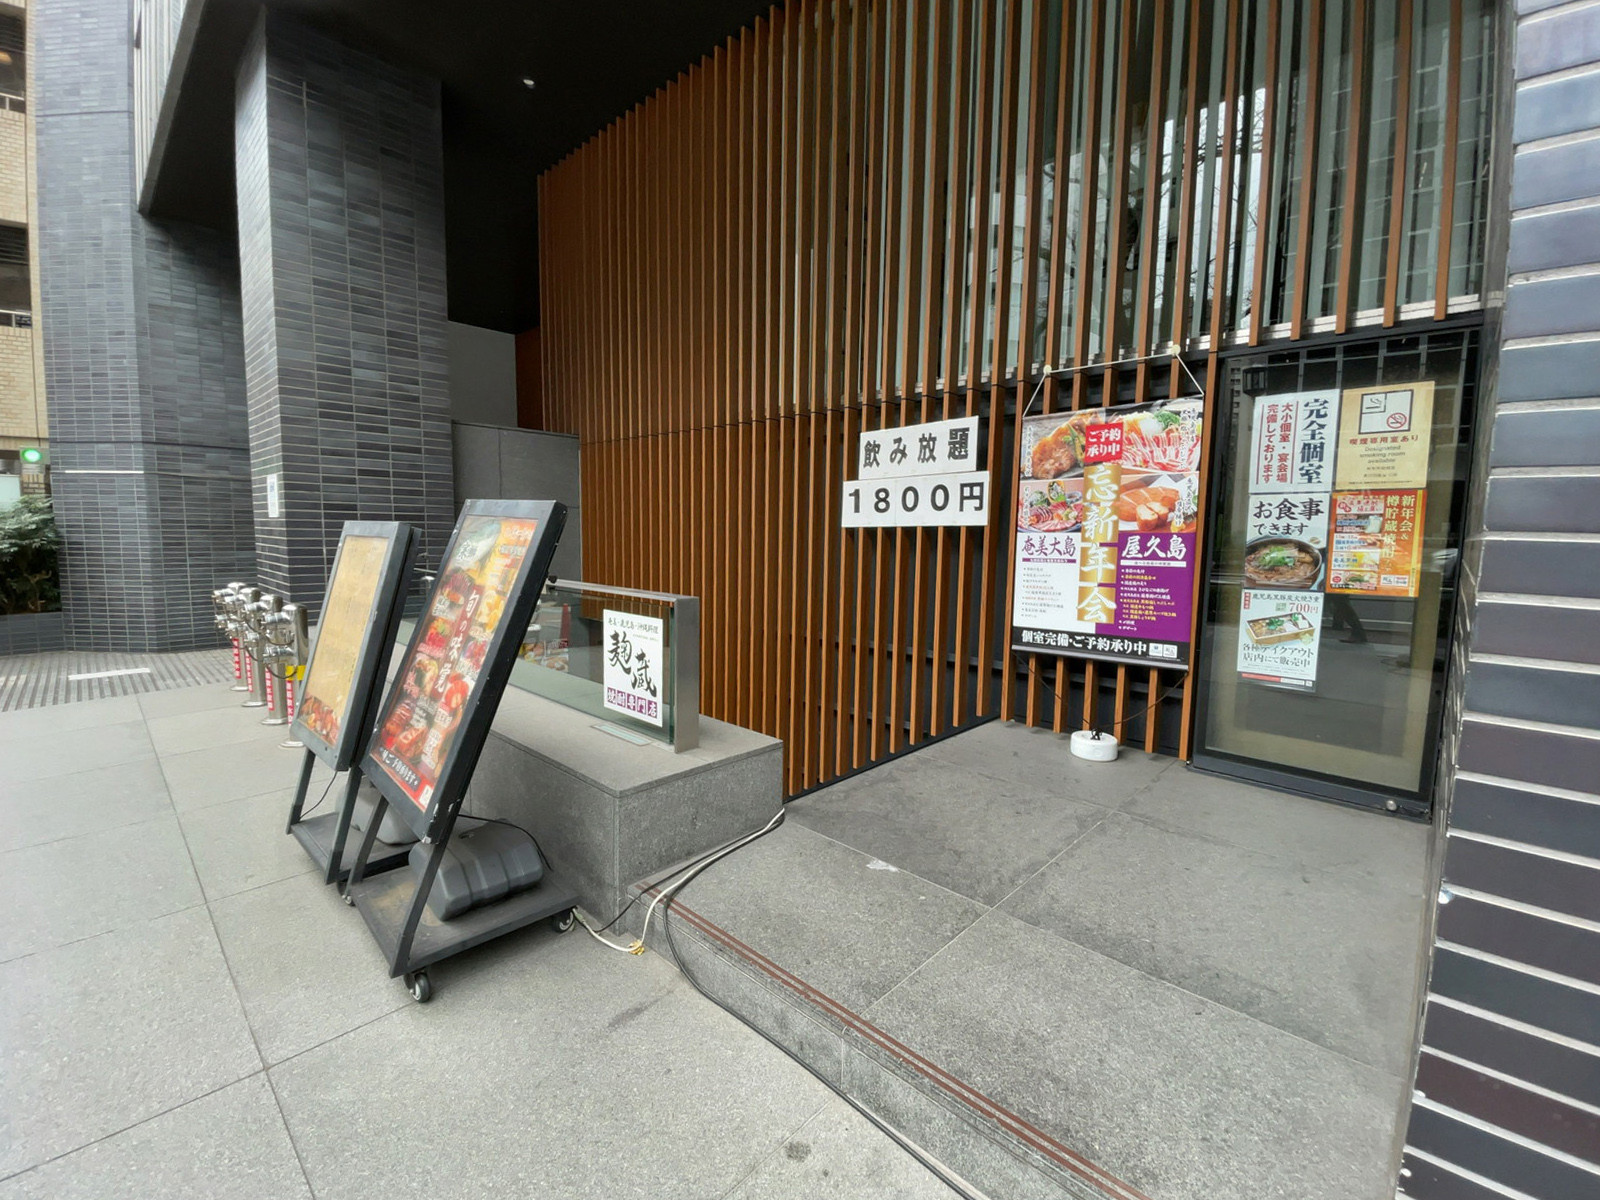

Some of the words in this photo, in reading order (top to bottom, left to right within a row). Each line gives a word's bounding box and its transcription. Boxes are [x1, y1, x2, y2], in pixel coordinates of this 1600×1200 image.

[1088, 428, 1121, 442] ご予約
[1262, 403, 1279, 483] 完備しております
[1276, 402, 1293, 483] 大小個室・宴会場
[1297, 398, 1329, 484] 完全個室
[1349, 435, 1418, 445] 喫煙専用室あり
[863, 427, 970, 469] 飲み放題
[1087, 443, 1120, 457] 承り中
[849, 482, 984, 513] 1800円
[1253, 498, 1324, 521] お食事
[1253, 523, 1309, 536] できます
[1022, 535, 1077, 557] 奄美大島
[1077, 465, 1118, 622] 忘新年会
[1122, 535, 1187, 560] 屋久島
[1289, 603, 1319, 613] 700円
[1021, 630, 1148, 655] 個室完備・ご予約承り中
[1243, 652, 1311, 667] 店内にて販売中
